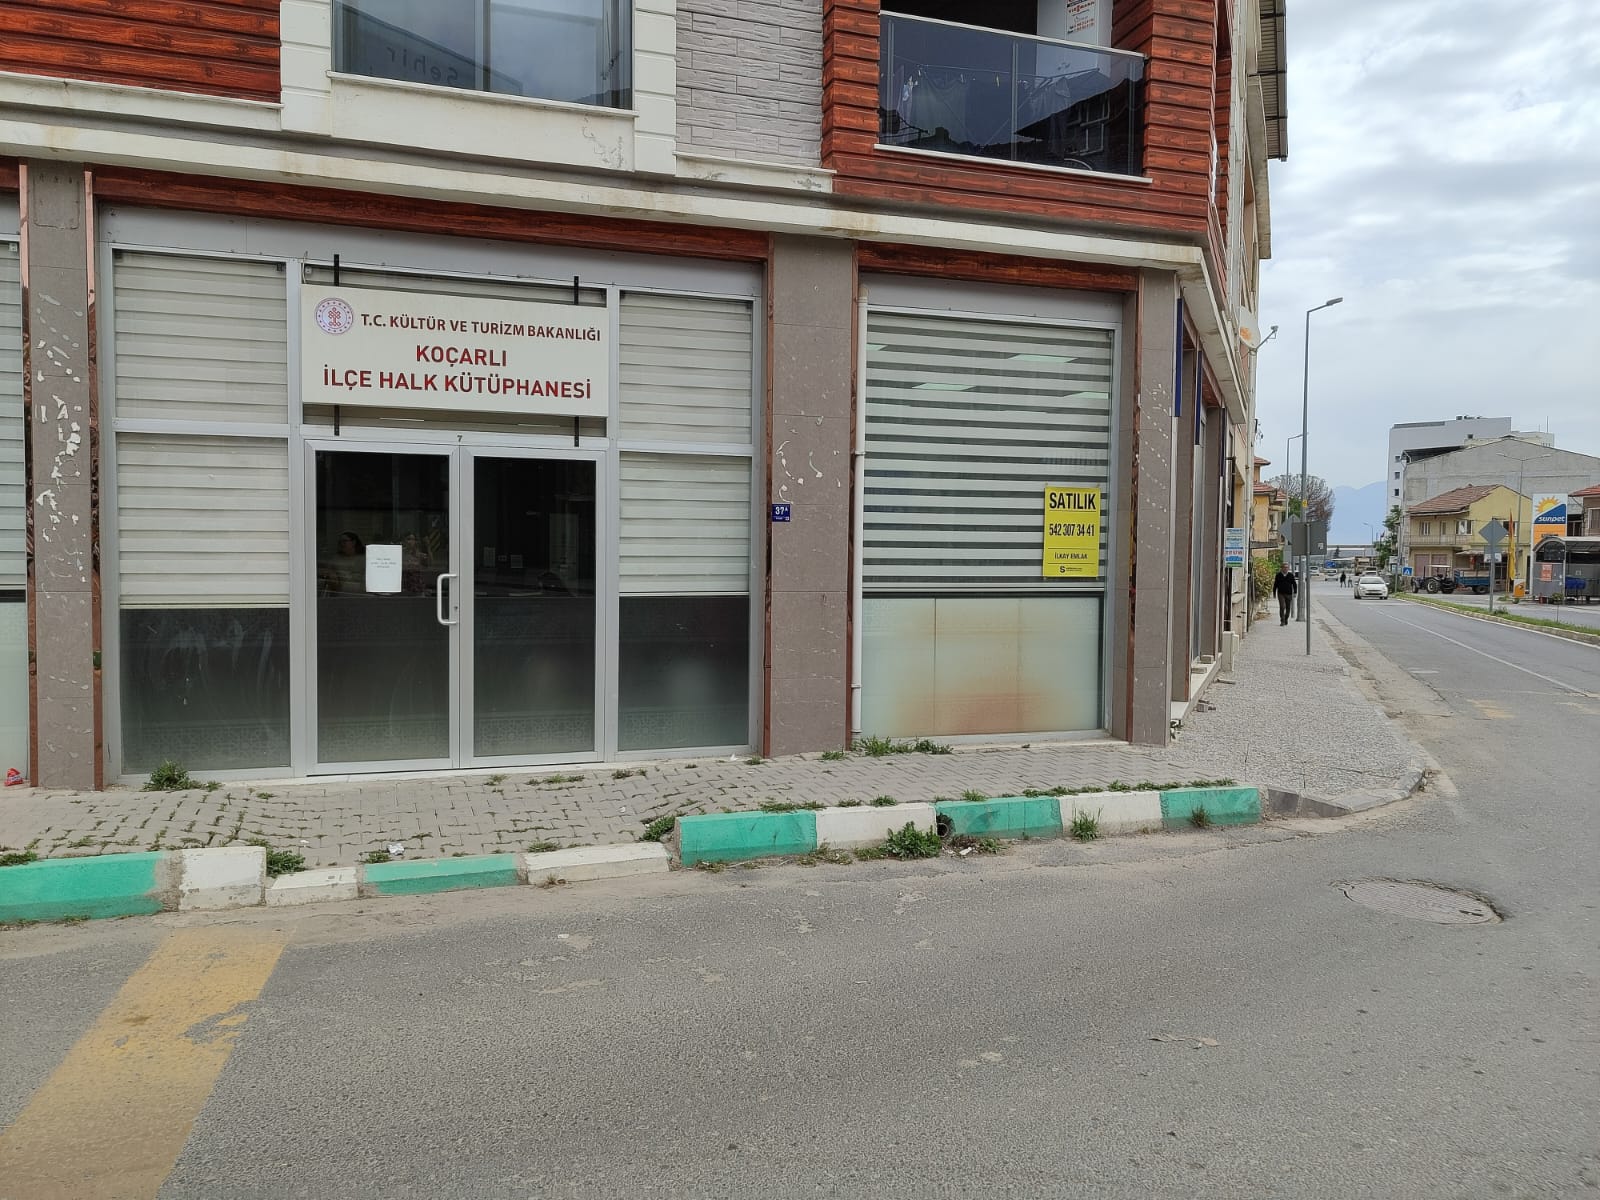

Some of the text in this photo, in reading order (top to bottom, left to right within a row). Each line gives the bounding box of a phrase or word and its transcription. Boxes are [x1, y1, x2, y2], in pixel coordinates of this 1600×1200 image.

[361, 313, 600, 341] T.C. KÜLTÜR VE TURİZM BAKANLIĞI
[416, 344, 507, 367] KOÇARLI
[323, 364, 592, 399] İLÇE HALK KÜTÜPHANESİ
[1049, 492, 1097, 510] SATILIK
[1049, 523, 1095, 537] 542 307 34 41
